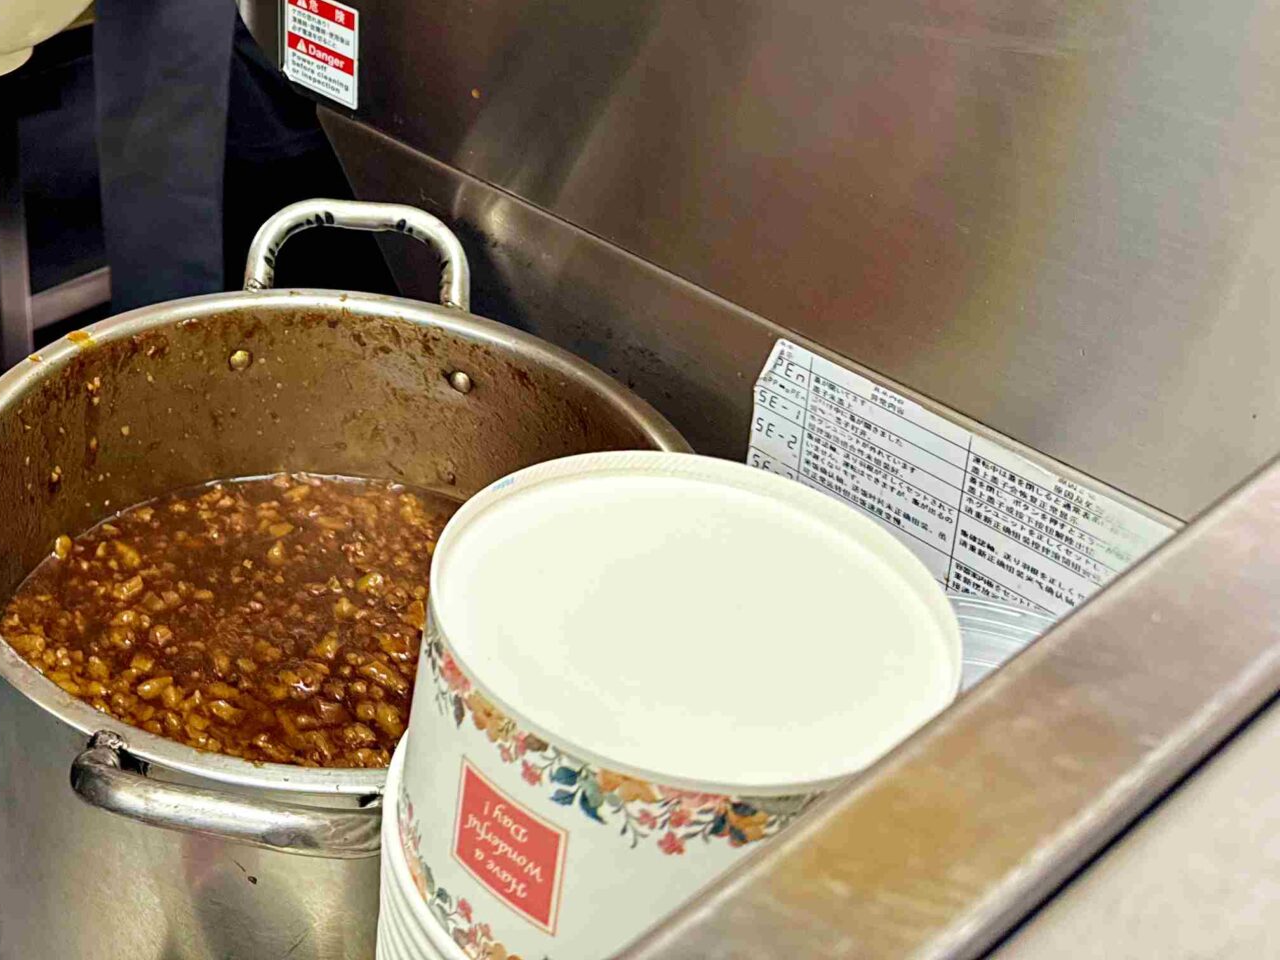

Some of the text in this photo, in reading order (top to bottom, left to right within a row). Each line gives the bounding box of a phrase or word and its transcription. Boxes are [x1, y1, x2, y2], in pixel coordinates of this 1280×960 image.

[292, 51, 326, 71] Power off
[308, 43, 344, 70] Danger
[292, 58, 348, 91] before cleaning
[301, 71, 339, 93] inspection
[464, 813, 544, 883] Wonderful
[473, 849, 528, 900] Have a
